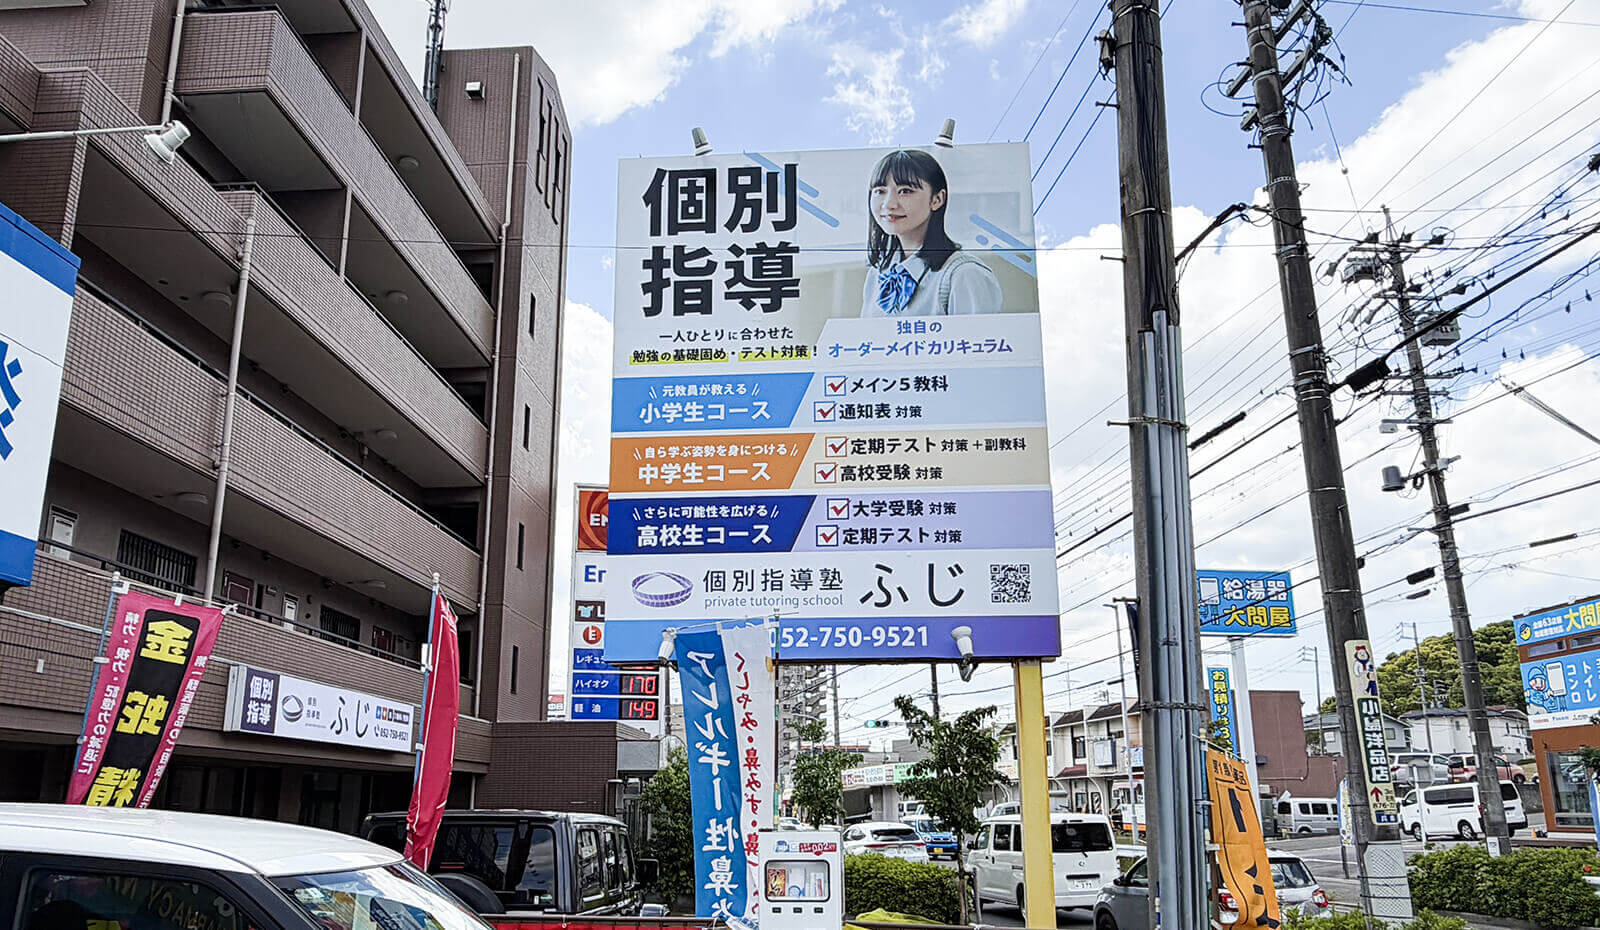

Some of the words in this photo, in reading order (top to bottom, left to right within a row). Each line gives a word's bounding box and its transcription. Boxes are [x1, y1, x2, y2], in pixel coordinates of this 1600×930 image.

[642, 163, 798, 237] 個別
[641, 241, 800, 318] 指導
[658, 327, 794, 344] 一人ひとりに合わせた
[896, 319, 943, 335] 独自の
[828, 338, 1013, 358] オーダーメイドカリキュラム
[661, 382, 747, 398] 元教員が教える
[639, 400, 771, 424] 小学生コース
[644, 443, 788, 460] 自ら学ぶ姿勢を身につける
[638, 461, 771, 485] 中学生コース
[643, 504, 769, 520] さらに可能性を広げる
[637, 523, 772, 548] 高校生コース
[703, 568, 844, 593] 個別指導塾
[859, 563, 965, 609] ふじ
[1223, 578, 1288, 602] 給湯器
[704, 596, 747, 610] private
[749, 594, 799, 609] tutoring
[801, 593, 844, 607] school
[1223, 604, 1293, 628] 大問屋
[768, 624, 930, 649] 052-750-9521
[250, 675, 275, 700] 個別
[575, 679, 609, 689] ハイオク
[629, 676, 656, 694] 170
[1566, 664, 1582, 703] コンロ
[1582, 660, 1597, 702] トイレ
[247, 700, 272, 726] 指導
[330, 696, 370, 738] ふじ
[628, 701, 655, 719] 149
